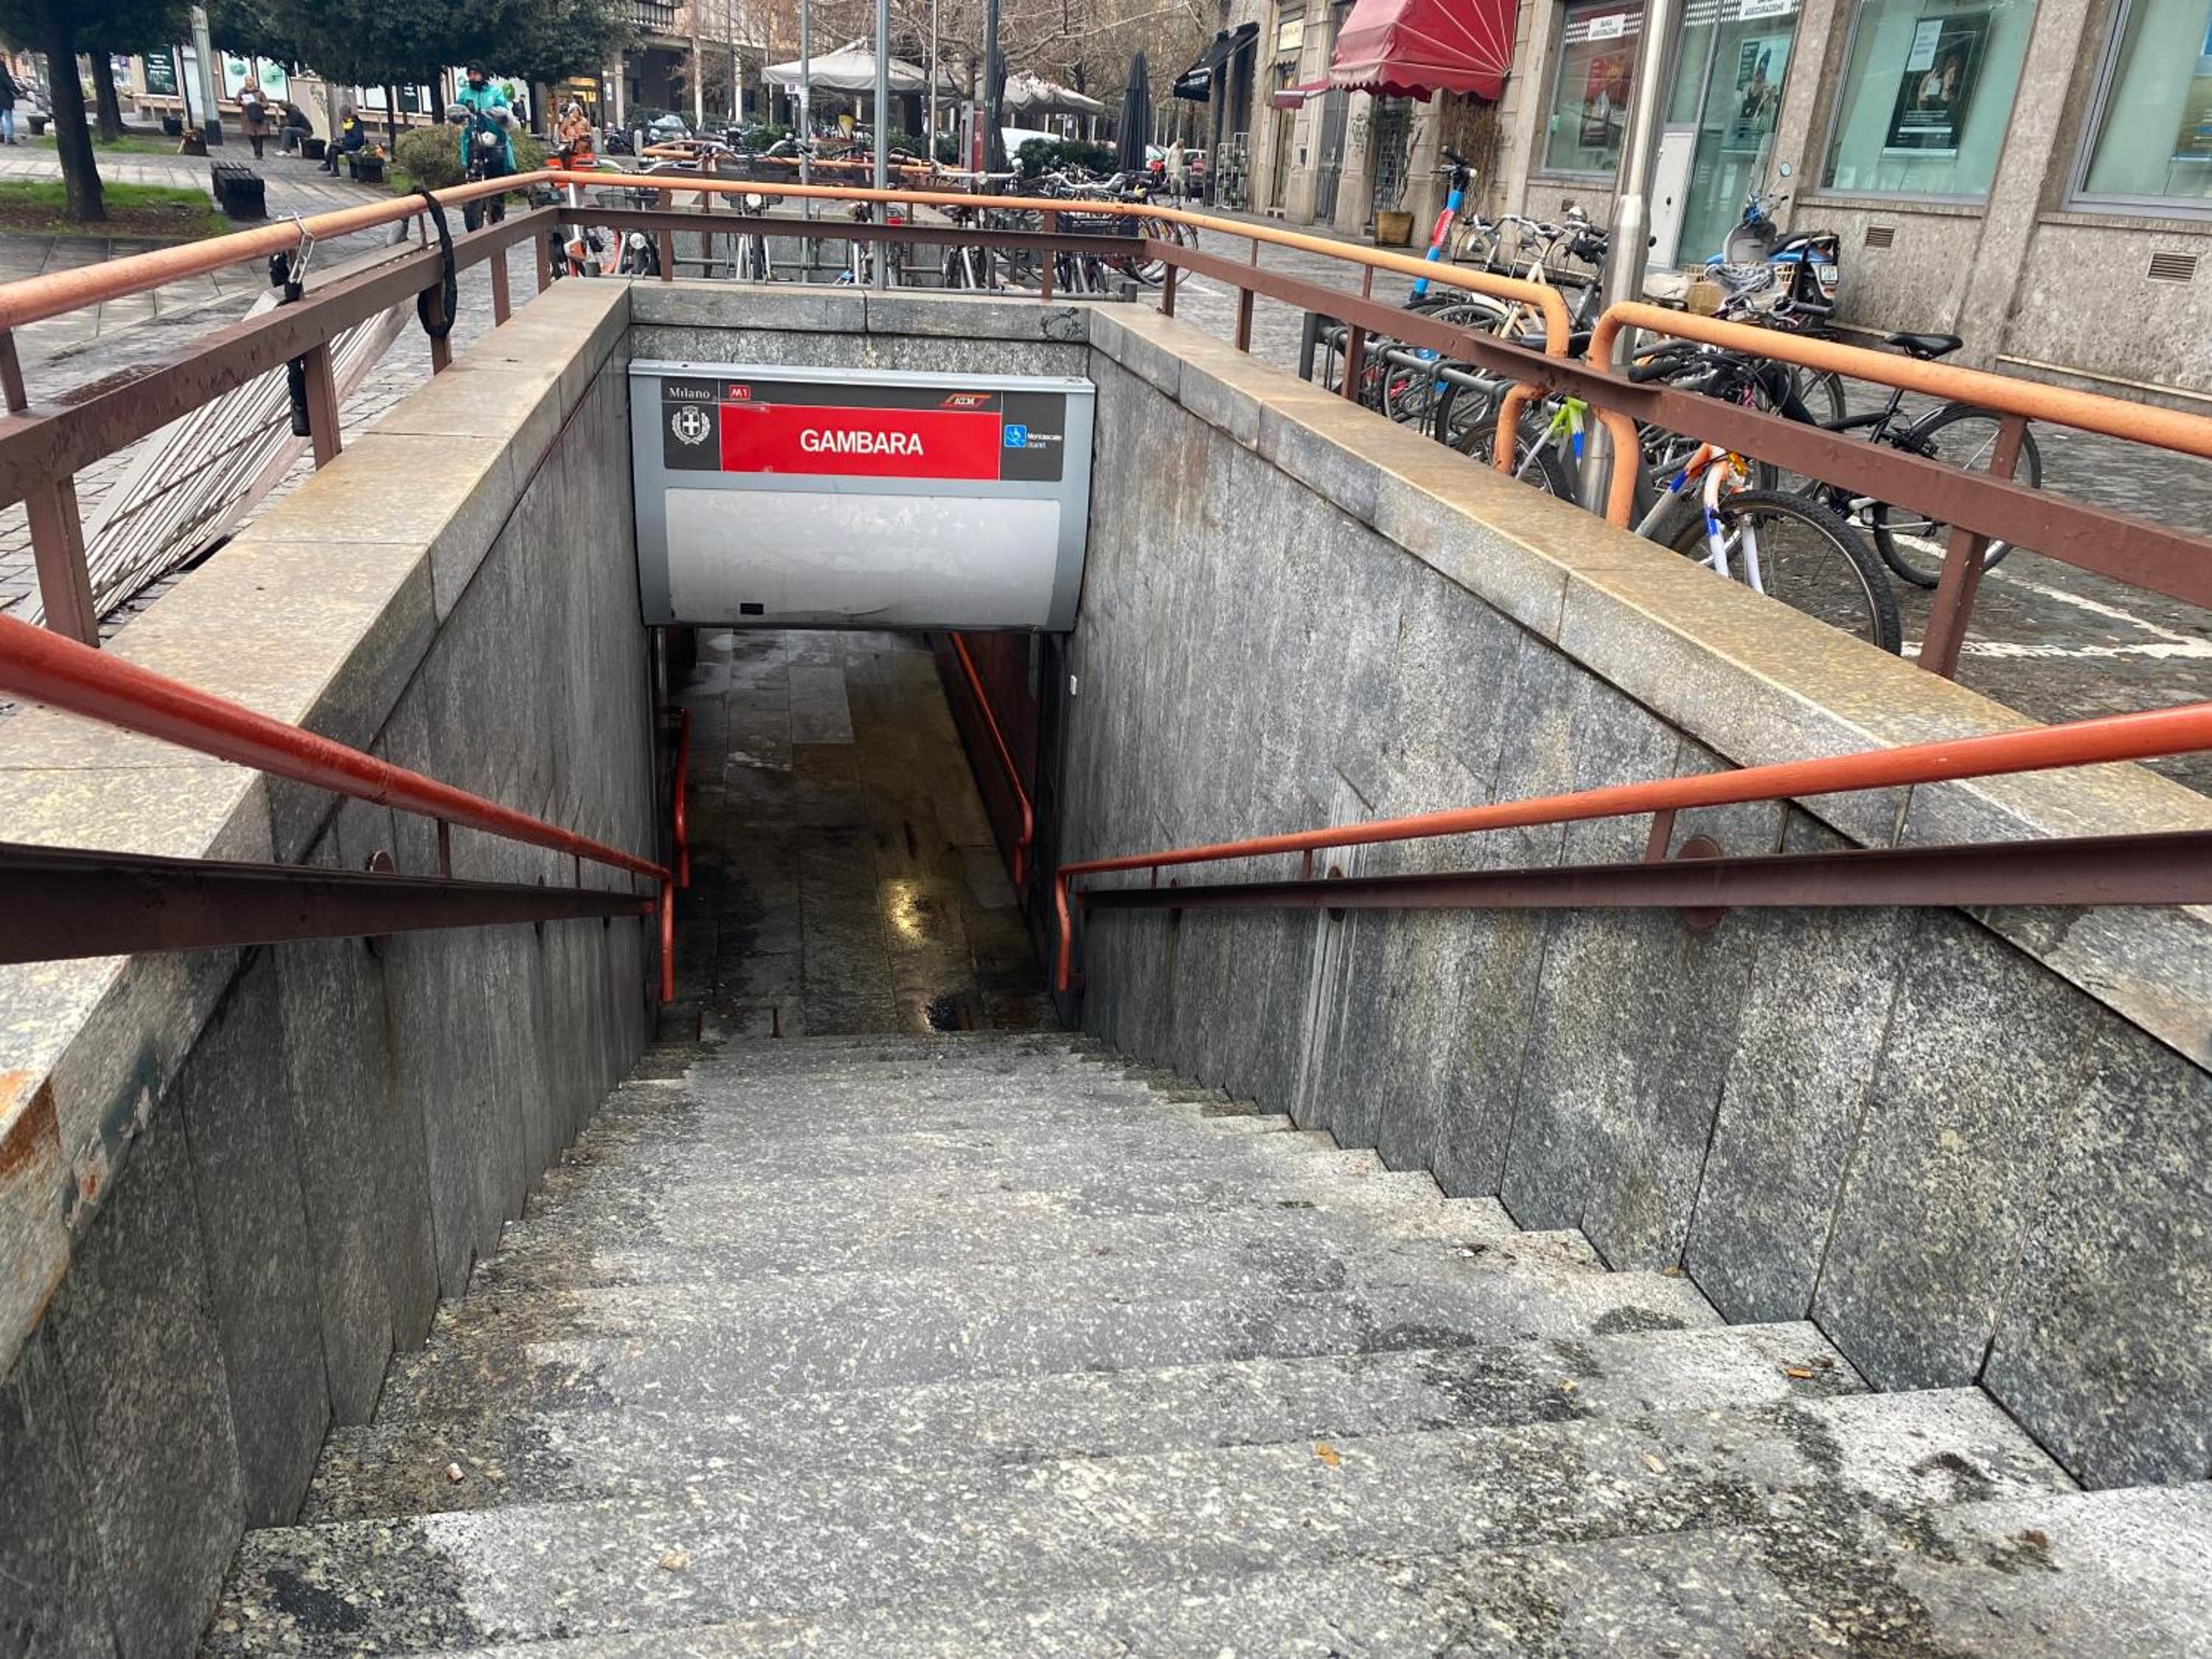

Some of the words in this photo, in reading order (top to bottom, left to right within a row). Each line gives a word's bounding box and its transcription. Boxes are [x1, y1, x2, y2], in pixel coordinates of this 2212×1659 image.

[669, 387, 710, 399] Milano
[731, 388, 748, 397] M1
[800, 428, 924, 456] GAMBARA
